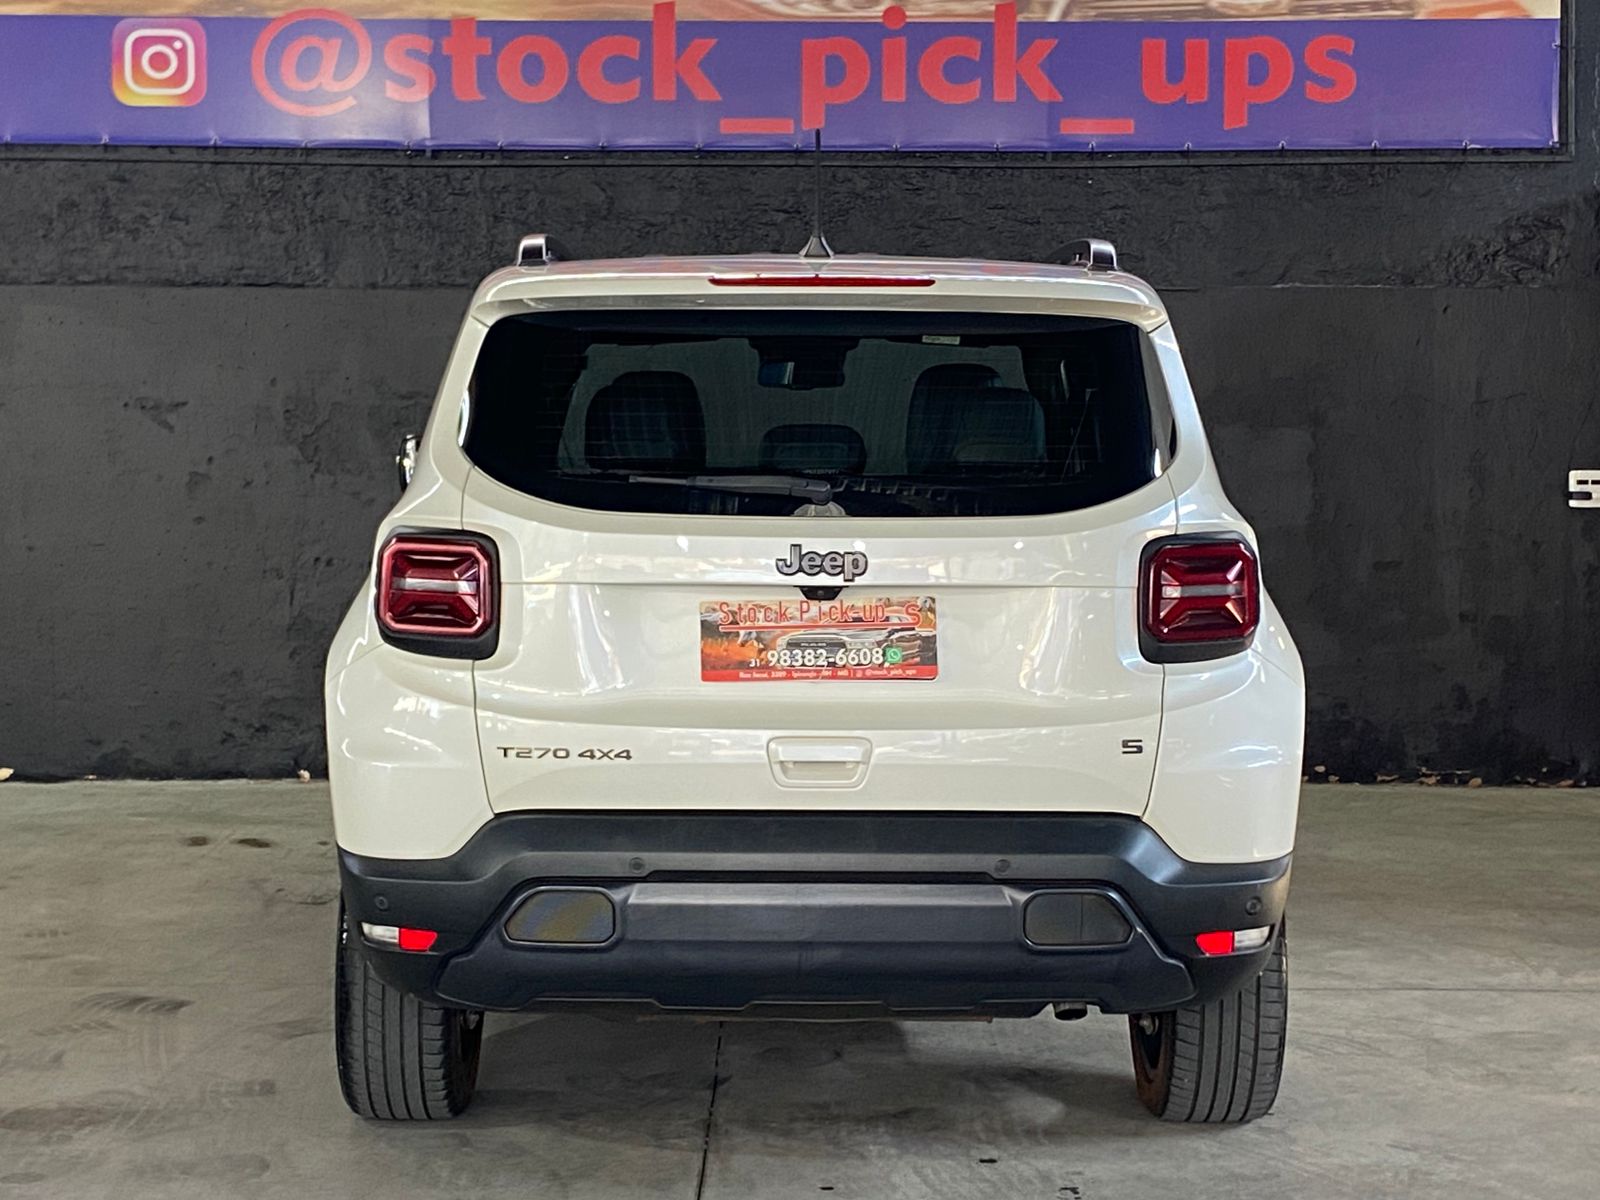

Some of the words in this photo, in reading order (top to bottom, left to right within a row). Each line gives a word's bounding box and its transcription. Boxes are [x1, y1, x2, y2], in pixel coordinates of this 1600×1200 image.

[251, 1, 1357, 135] @stock_pick_ups
[776, 544, 868, 582] Jeep
[719, 601, 790, 624] Stock
[749, 658, 760, 667] 31
[766, 648, 884, 667] 98382-6608
[497, 746, 570, 759] T270
[1122, 739, 1143, 754] S
